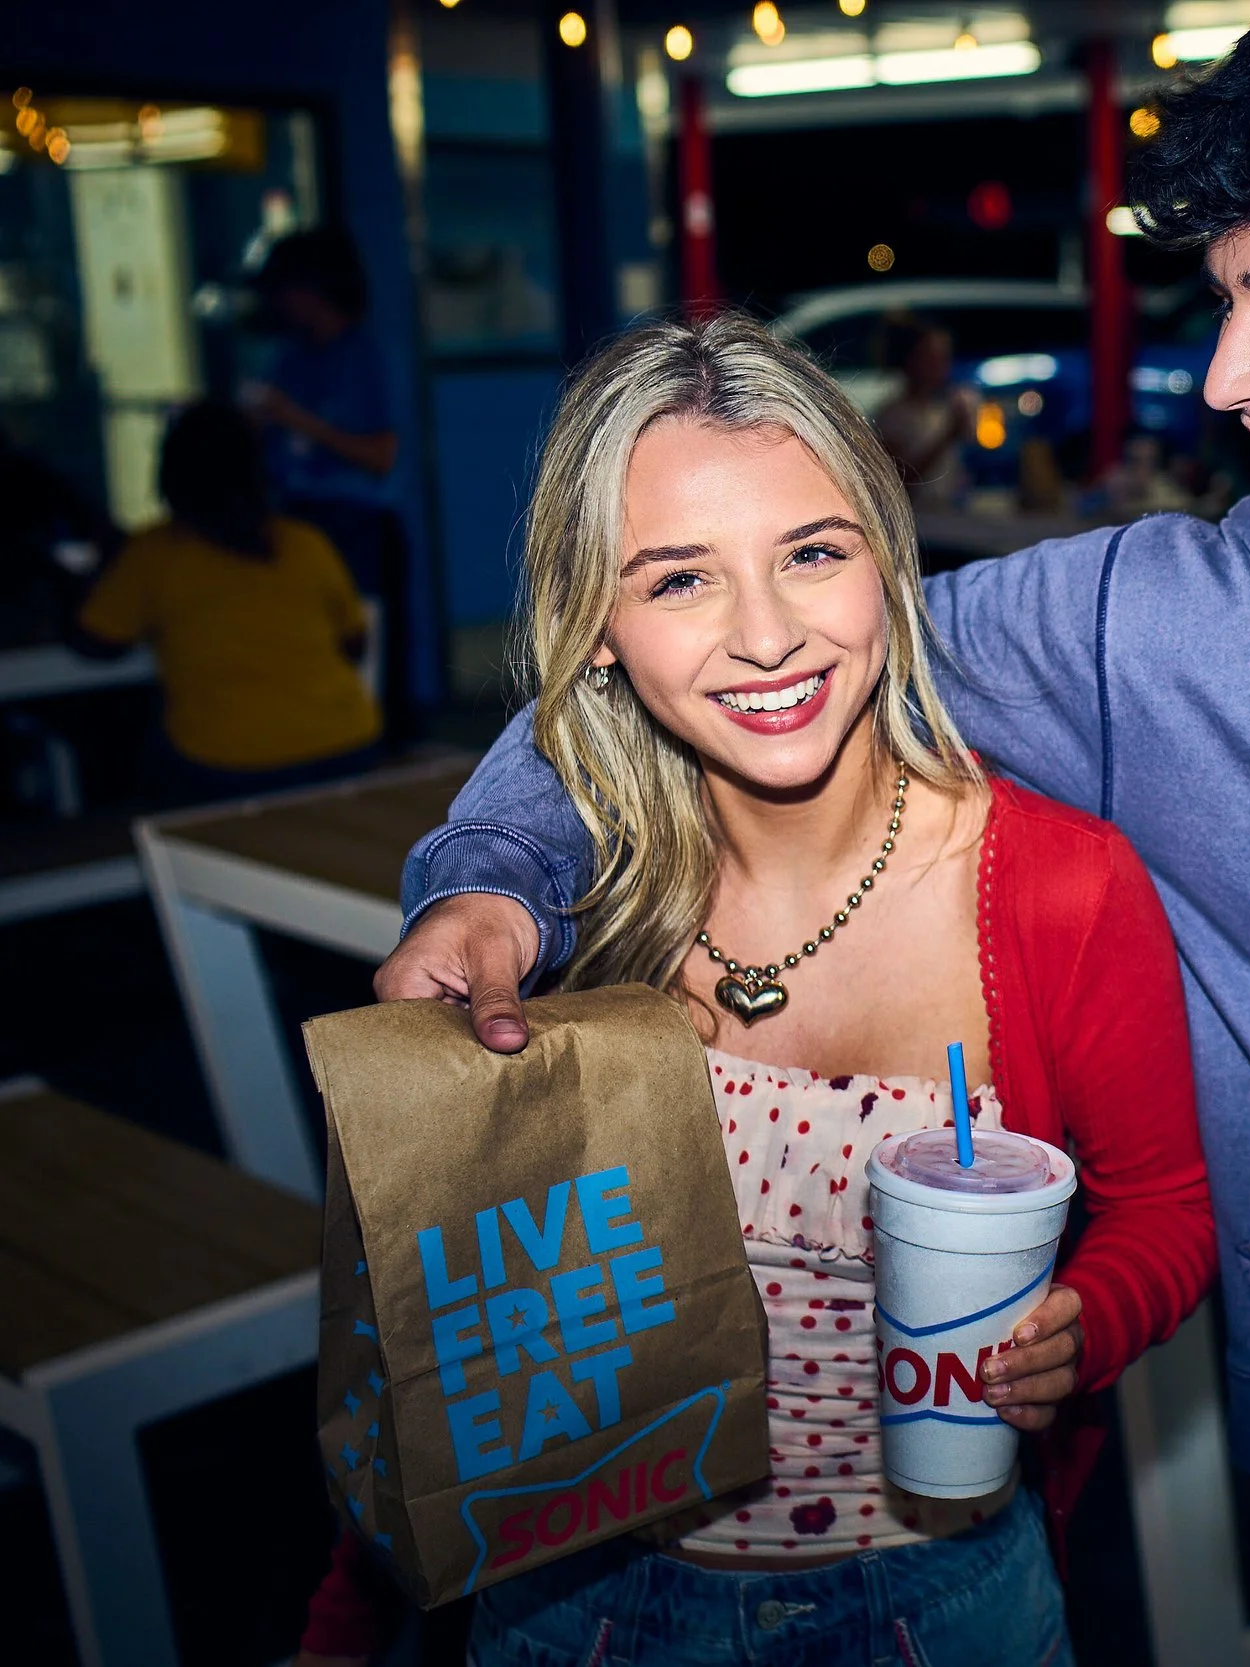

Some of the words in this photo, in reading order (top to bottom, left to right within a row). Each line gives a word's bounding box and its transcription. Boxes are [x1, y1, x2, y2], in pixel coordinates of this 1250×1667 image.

[416, 1165, 644, 1311] LIVE
[431, 1246, 676, 1397] FREE
[446, 1344, 634, 1483] EAT
[489, 1448, 688, 1571] SONIC
